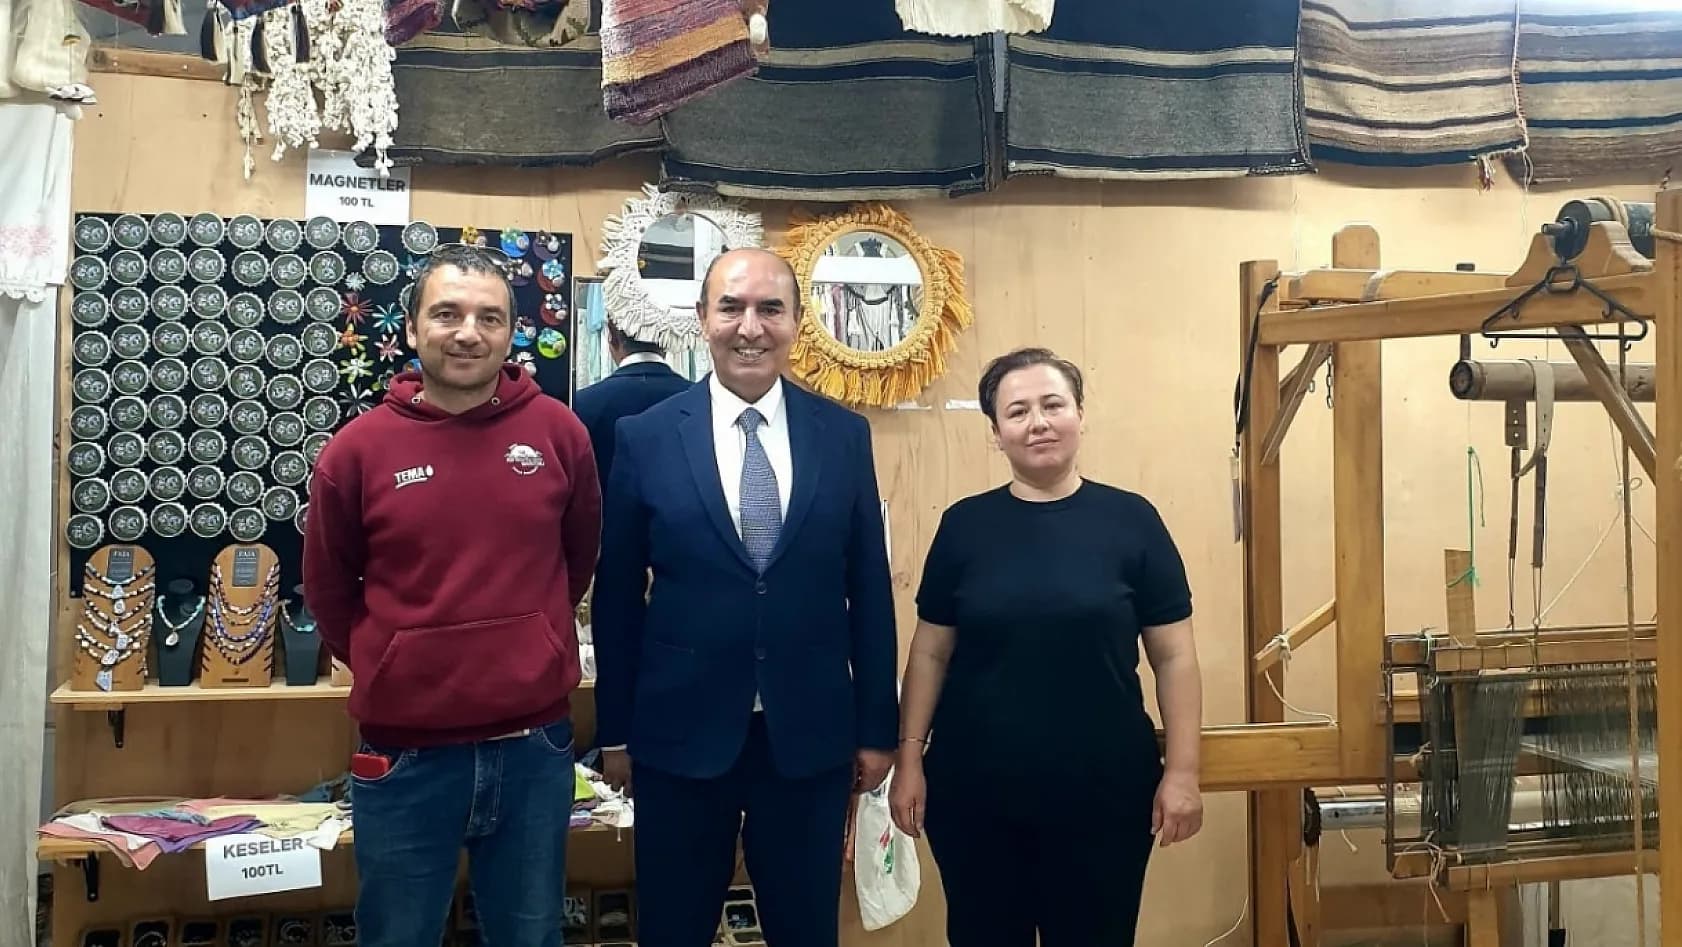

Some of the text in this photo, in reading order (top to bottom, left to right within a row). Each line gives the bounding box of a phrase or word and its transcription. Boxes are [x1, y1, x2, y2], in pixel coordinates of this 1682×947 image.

[310, 173, 405, 192] MAGNETLER
[339, 196, 374, 208] 100 TL
[394, 467, 426, 485] TEMA
[223, 838, 303, 859] KESELER
[241, 863, 284, 879] 100TL
